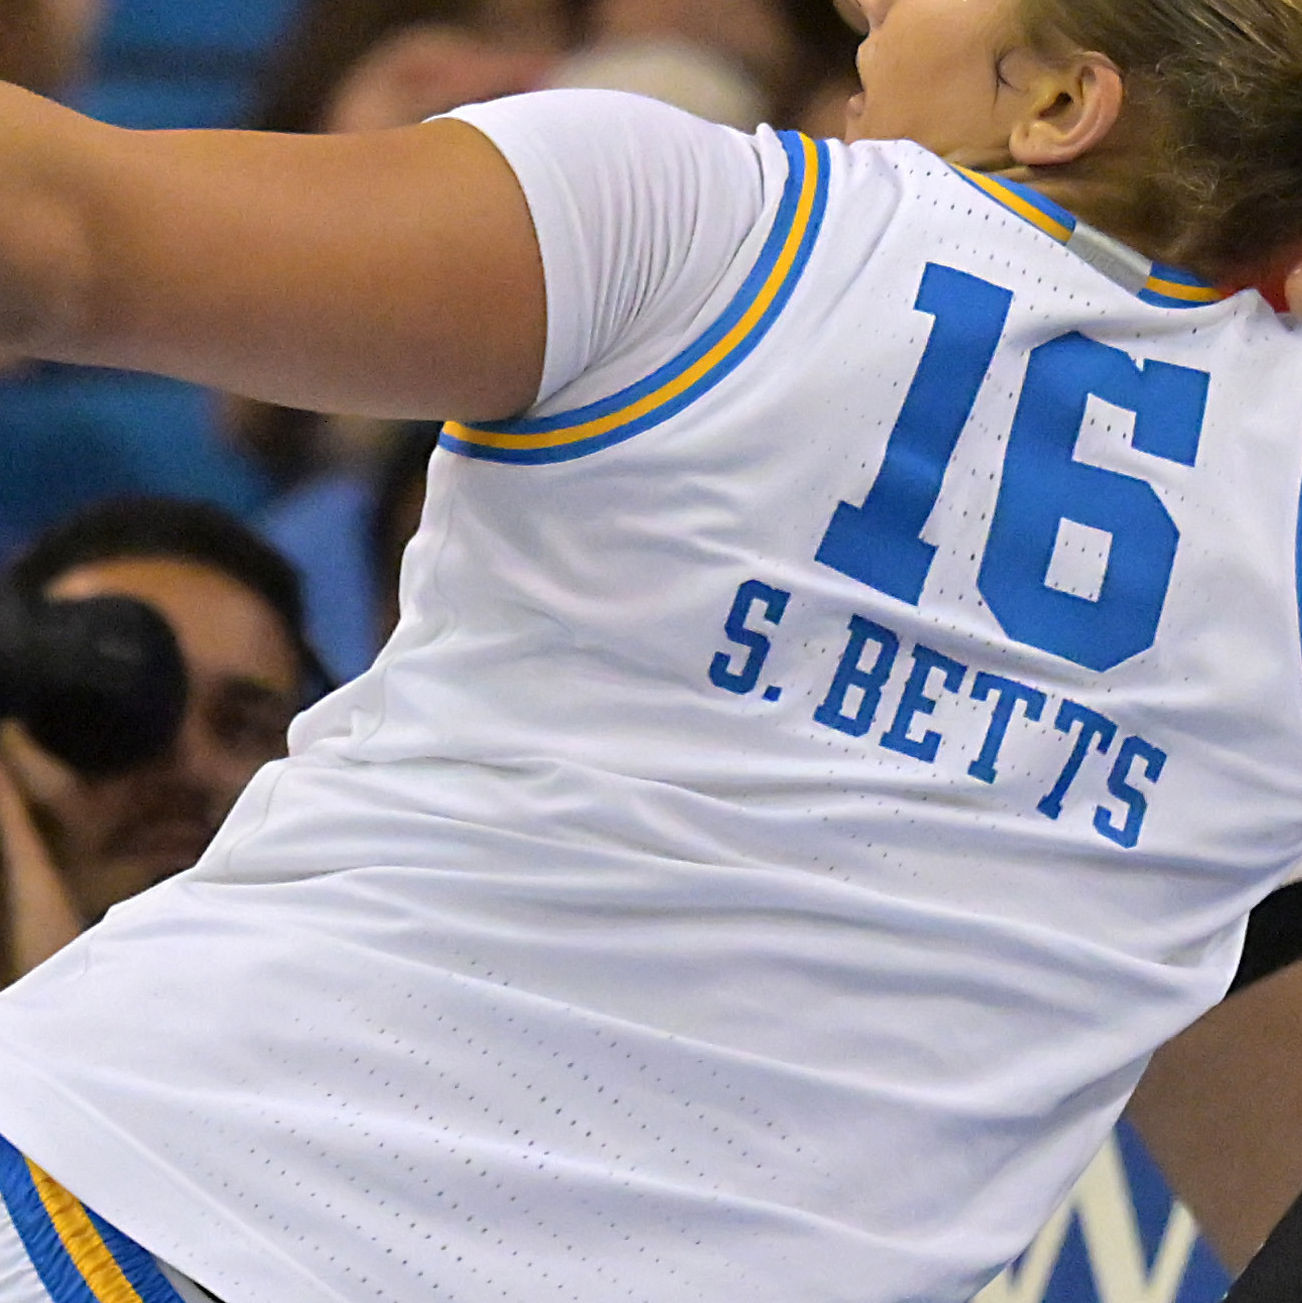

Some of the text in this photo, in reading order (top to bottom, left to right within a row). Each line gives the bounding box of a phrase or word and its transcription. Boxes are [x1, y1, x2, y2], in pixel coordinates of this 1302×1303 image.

[814, 261, 1210, 672] 16
[708, 579, 1166, 849] S. BETTS
